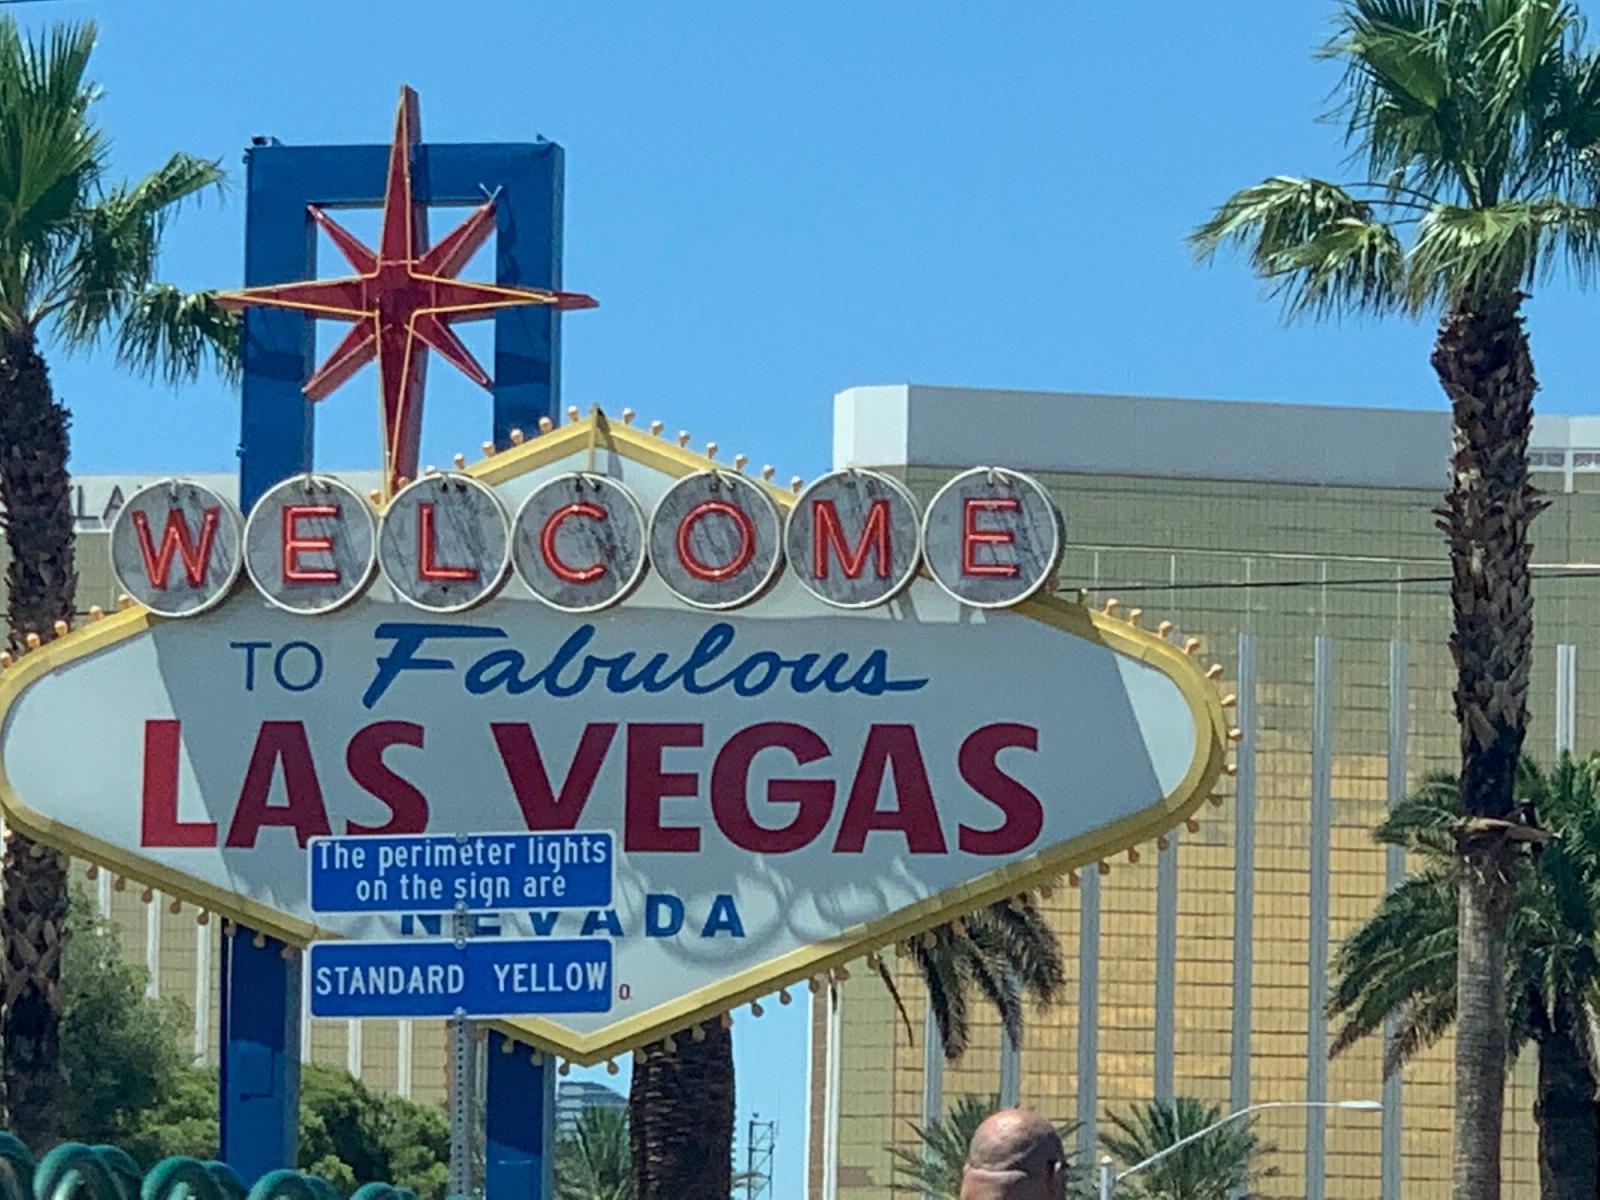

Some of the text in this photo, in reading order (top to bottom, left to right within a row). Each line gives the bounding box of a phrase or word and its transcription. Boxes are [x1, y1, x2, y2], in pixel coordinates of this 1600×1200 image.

[132, 495, 1022, 592] WELCOME
[230, 621, 928, 710] TO Fabulous
[141, 718, 1044, 855] LAS VEGAS
[317, 836, 607, 877] The perimeter lights
[356, 871, 567, 907] on the sign are
[315, 961, 608, 996] STANDARD YELLOW
